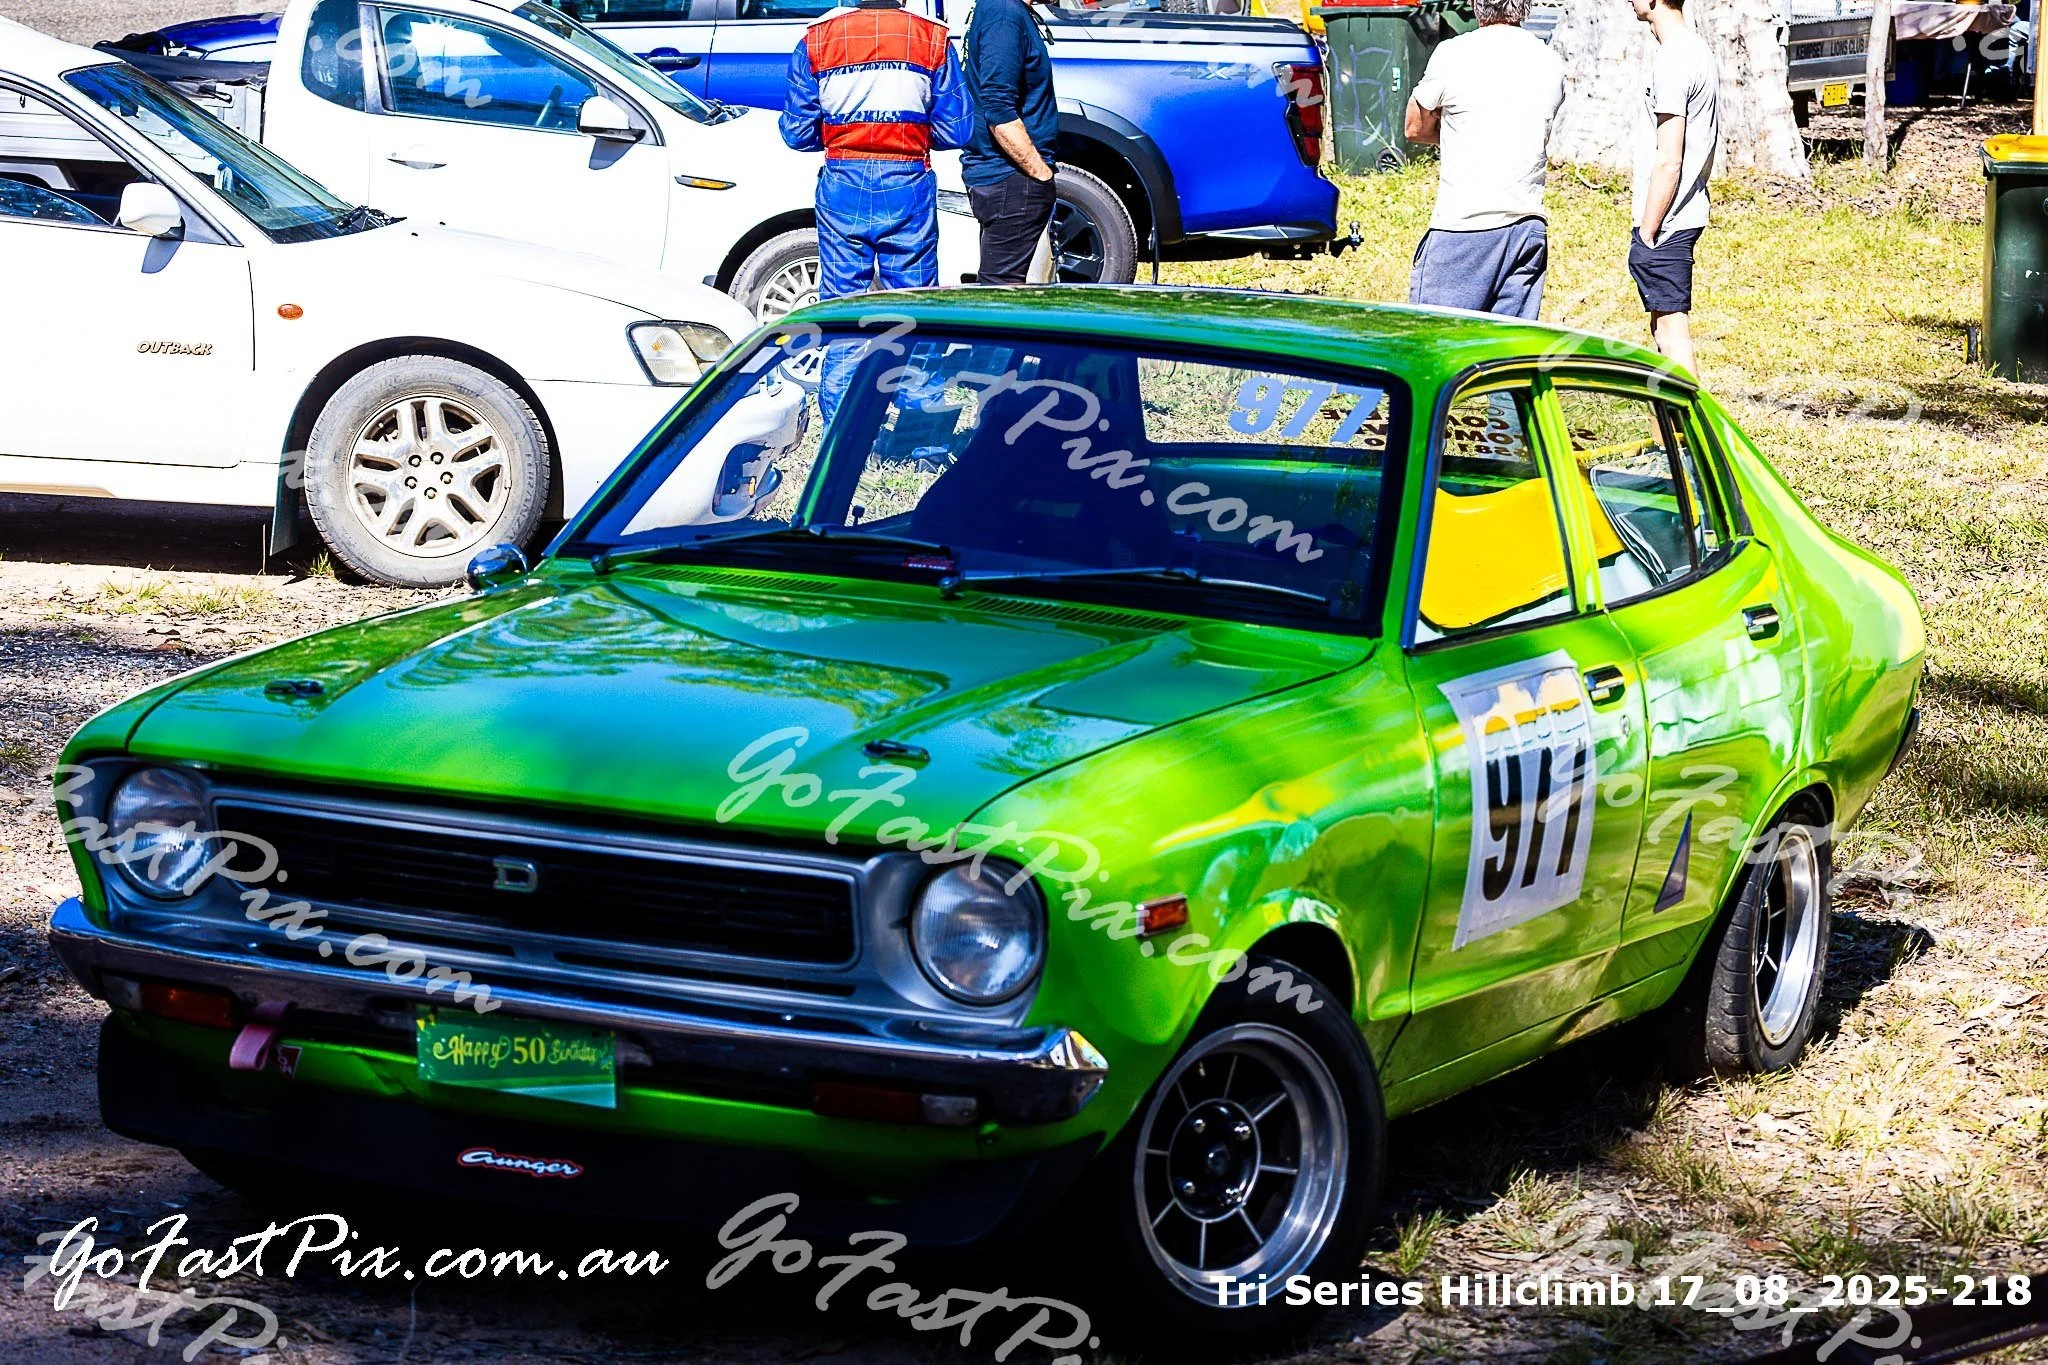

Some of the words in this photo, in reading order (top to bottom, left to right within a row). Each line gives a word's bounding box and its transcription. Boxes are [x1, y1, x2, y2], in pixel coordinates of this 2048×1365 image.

[136, 340, 213, 356] OUTBACK
[1228, 376, 1385, 443] 977
[1482, 700, 1588, 901] 977
[433, 1033, 511, 1069] Happy
[513, 1036, 546, 1065] 50
